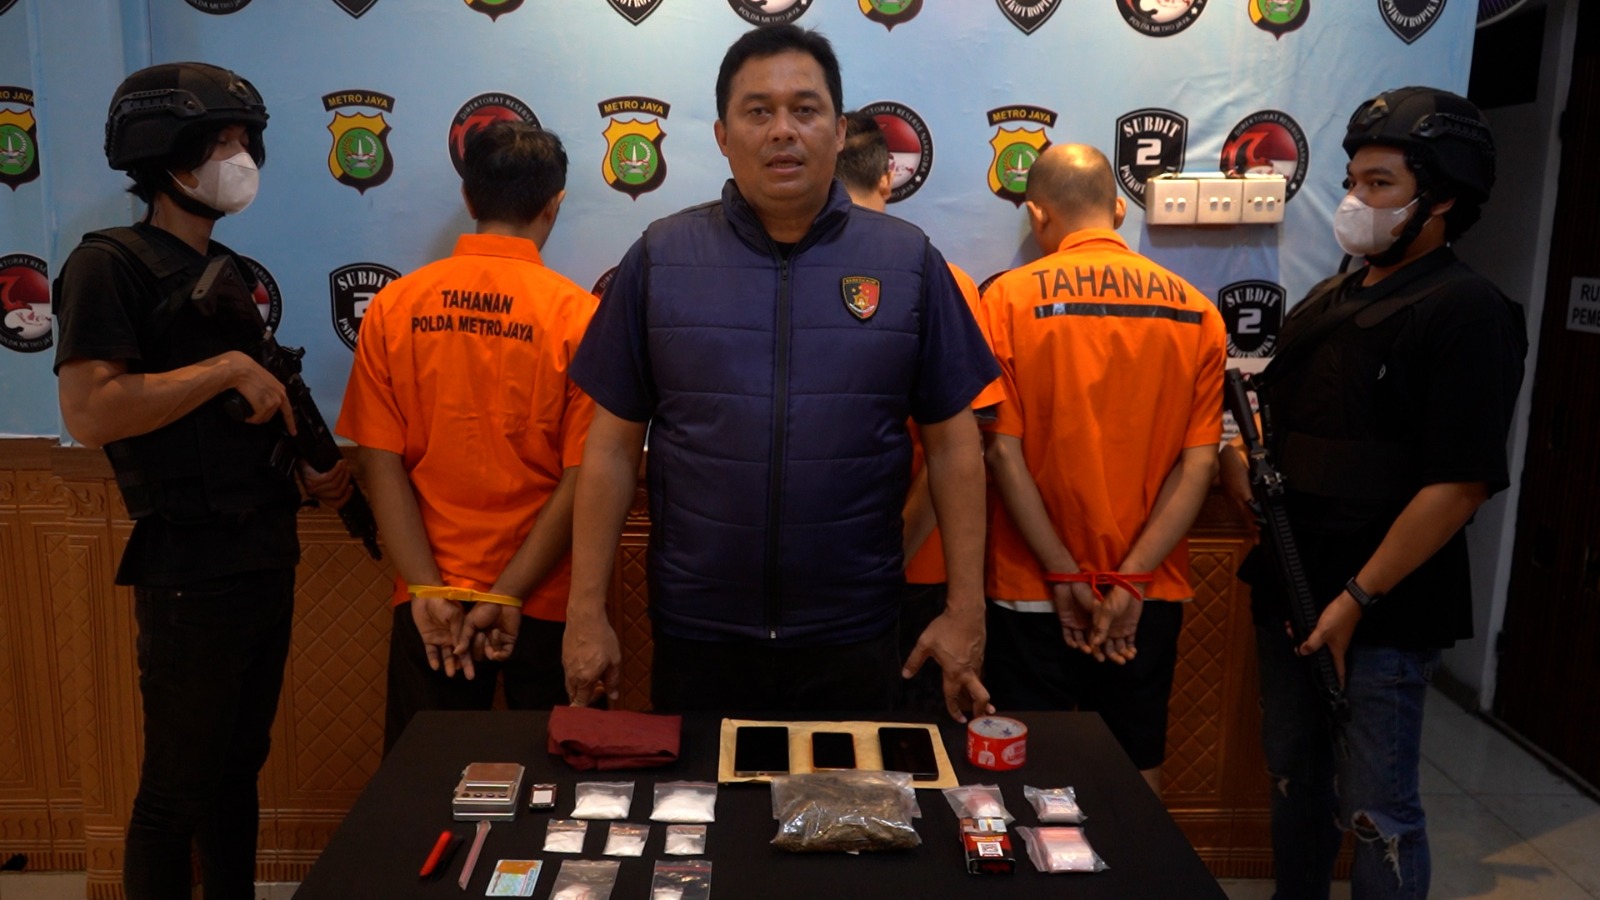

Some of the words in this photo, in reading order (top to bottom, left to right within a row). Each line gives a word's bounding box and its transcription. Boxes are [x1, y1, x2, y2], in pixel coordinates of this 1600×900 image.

[738, 6, 760, 22] POLDA
[760, 15, 786, 23] METRO
[786, 7, 801, 21] JAYA
[1129, 16, 1151, 31] POLDA
[1151, 24, 1175, 33] METRO
[1175, 16, 1191, 30] JAYA
[328, 94, 362, 107] METRO
[364, 94, 389, 109] JAYA
[459, 95, 503, 120] DIREKTORAT
[506, 98, 534, 123] RESERSE
[604, 100, 639, 113] METRO
[640, 101, 664, 114] JAYA
[992, 110, 1027, 121] METRO
[1027, 110, 1051, 123] JAYA
[1123, 116, 1181, 138] SUBDIT
[896, 107, 922, 135] RESERSE
[920, 131, 930, 173] NARKOBA
[1136, 138, 1162, 166] 2
[1234, 113, 1278, 136] DIREKTORAT
[1278, 116, 1301, 139] RESERSE
[1295, 140, 1305, 180] NARKOBA
[1031, 264, 1188, 305] TAHANAN
[1580, 284, 1600, 303] RU
[268, 284, 279, 323] NARKOBA
[441, 290, 514, 315] TAHANAN
[1225, 287, 1280, 308] SUBDIT
[411, 315, 453, 334] POLDA
[458, 315, 502, 336] METRO
[502, 321, 534, 344] JAYA
[1237, 307, 1262, 335] 2
